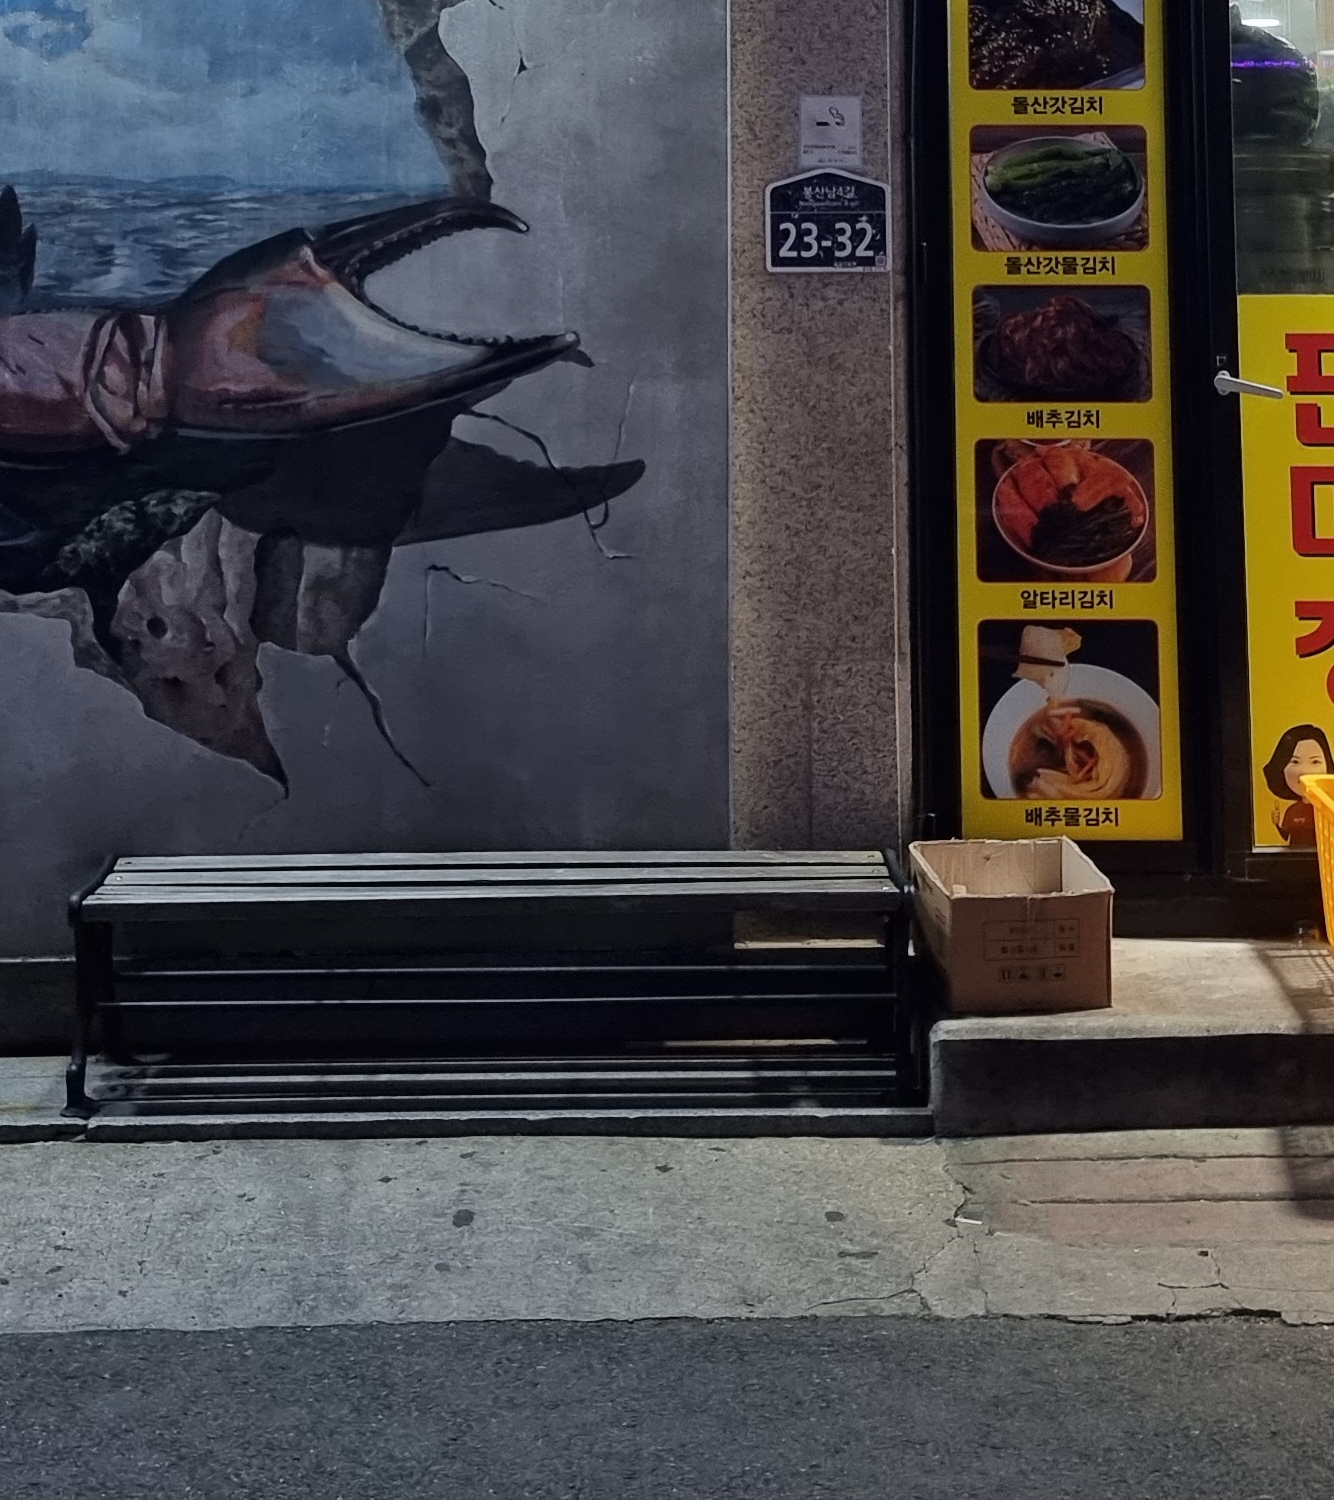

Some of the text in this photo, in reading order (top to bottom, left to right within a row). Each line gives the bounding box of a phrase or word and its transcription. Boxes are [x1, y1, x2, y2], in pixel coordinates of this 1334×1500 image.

[1010, 95, 1104, 116] 돌산갓김치
[778, 221, 875, 258] 23-32
[1003, 254, 1117, 276] 돌산갓물김치
[1025, 408, 1101, 430] 배추김치
[1019, 588, 1115, 610] 알타리김치
[1024, 805, 1120, 827] 배추물김치
